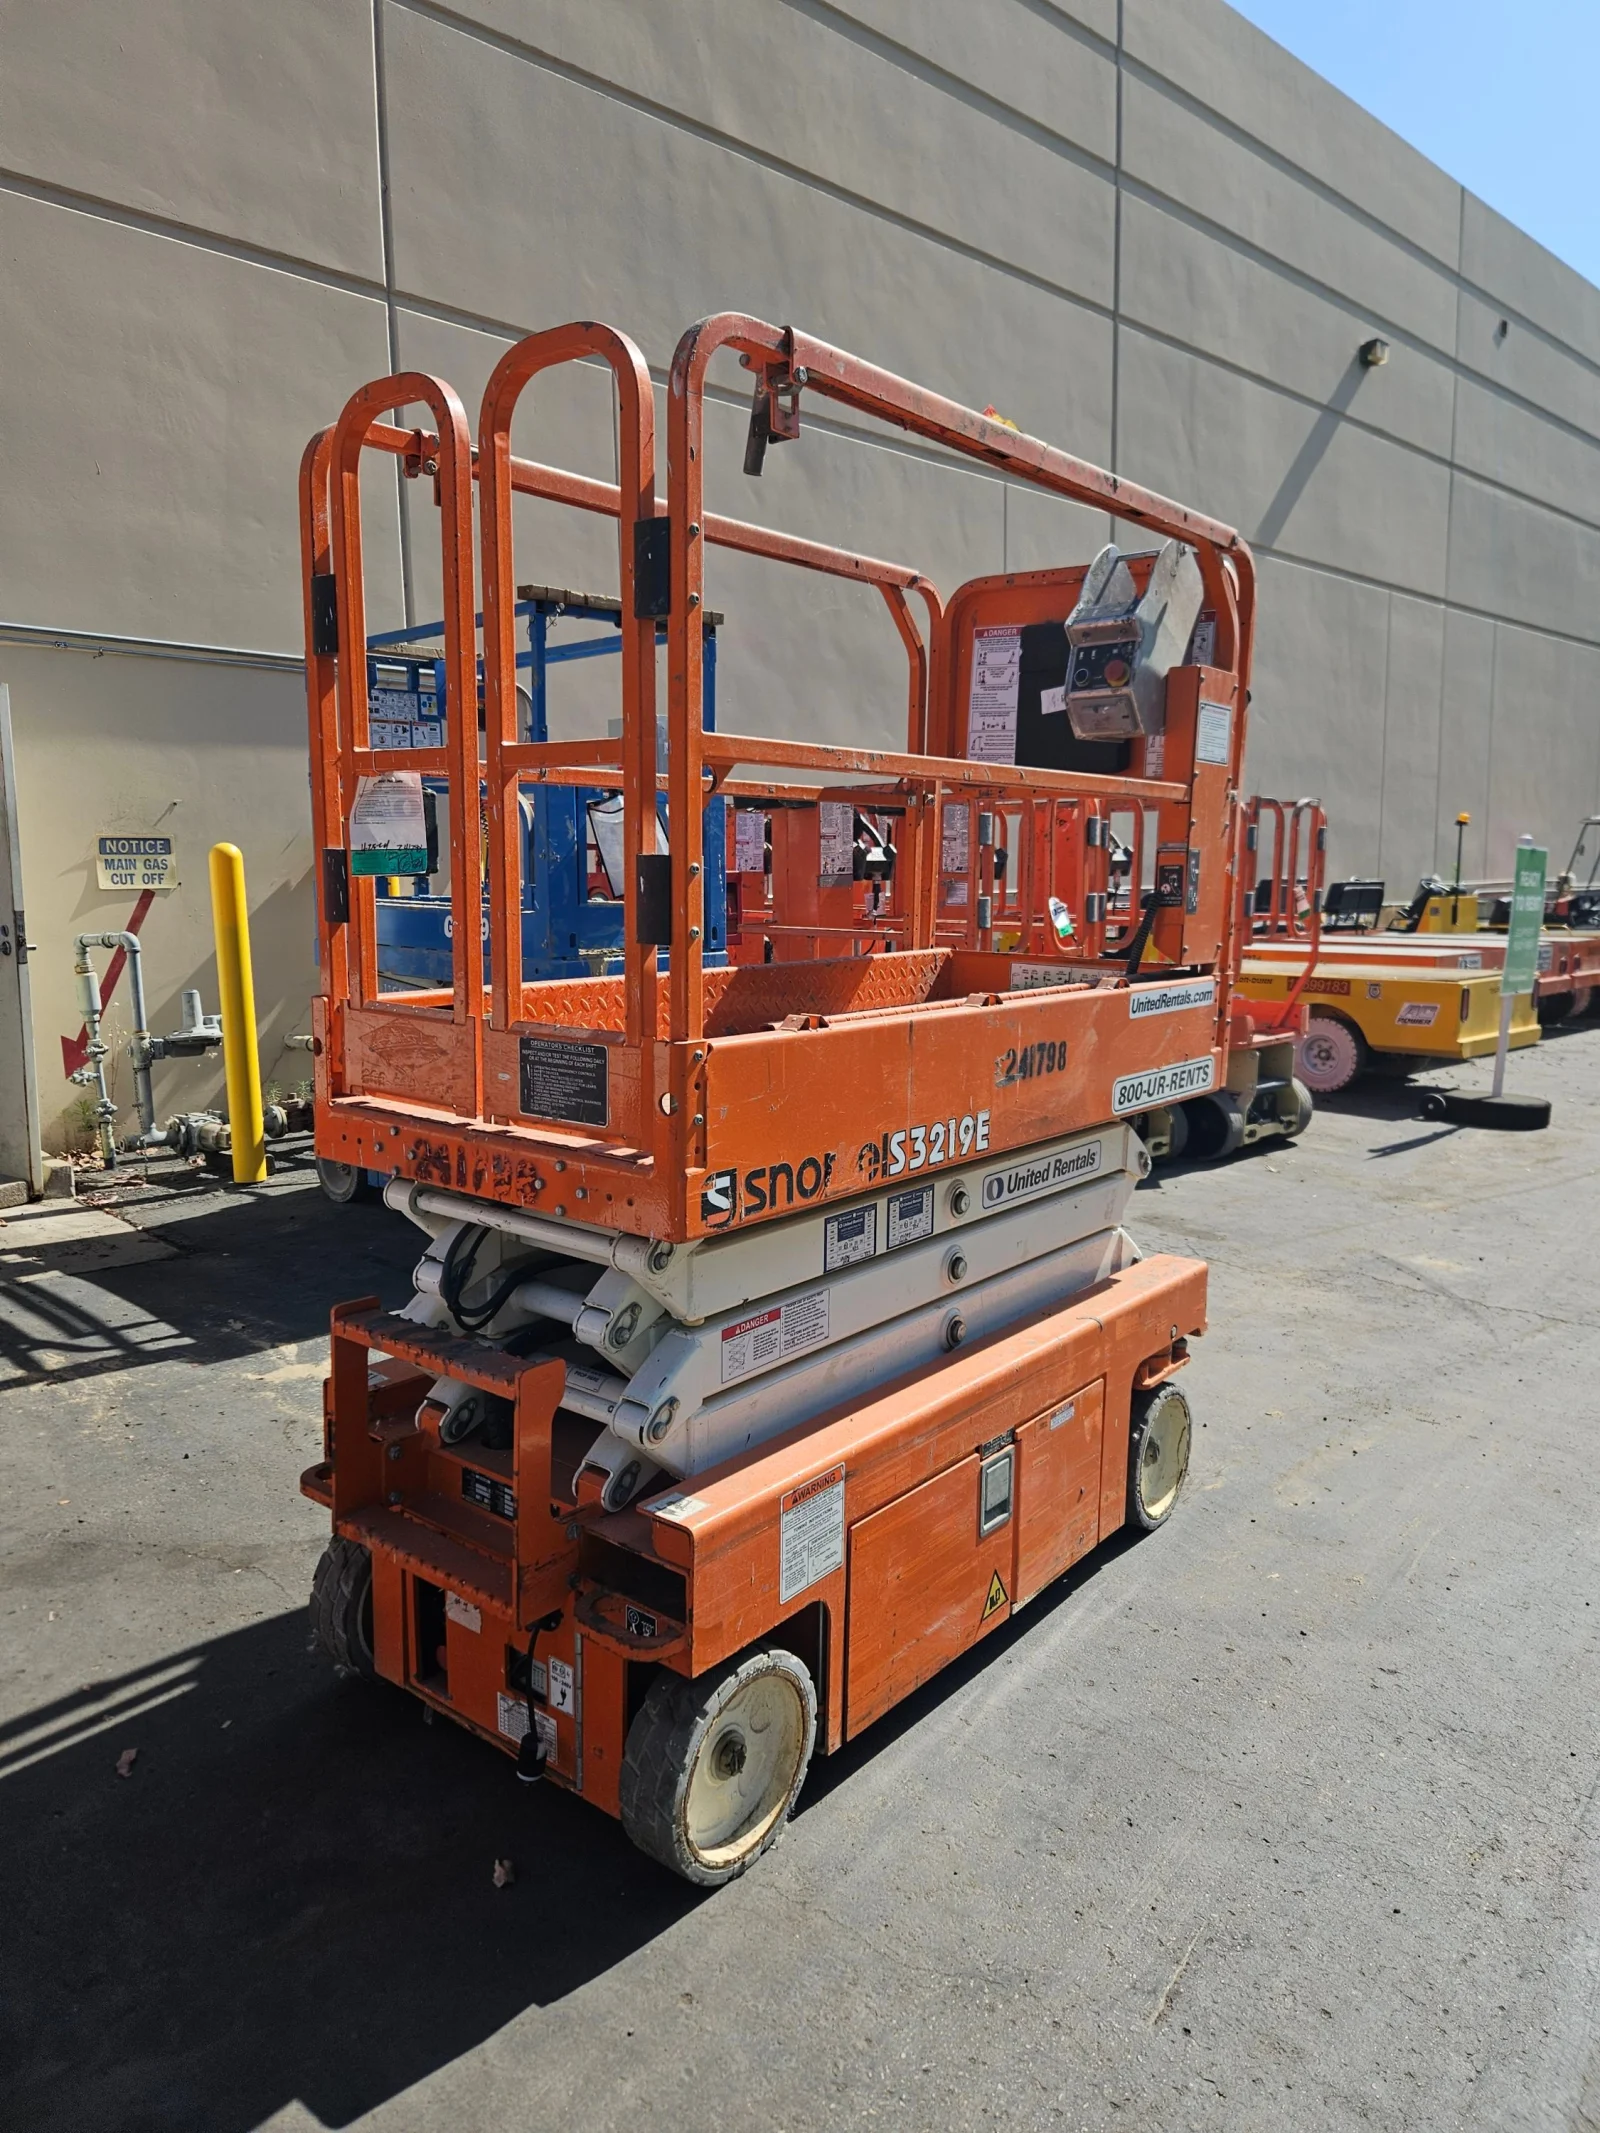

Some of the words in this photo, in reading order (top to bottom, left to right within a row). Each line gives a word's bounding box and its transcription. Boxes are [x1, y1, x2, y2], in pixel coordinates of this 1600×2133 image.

[988, 628, 1017, 637] DANGER
[105, 840, 165, 853] NOTICE
[104, 858, 137, 871] MAIN
[143, 858, 169, 871] GAS
[111, 873, 136, 885] CUT
[142, 873, 165, 885] OFF
[1131, 989, 1213, 1014] UnitedRentals.com
[563, 1045, 595, 1053] CHECKLIST
[1003, 1041, 1067, 1082] 241798
[1118, 1064, 1211, 1106] 800-UR-RENTS
[889, 1108, 992, 1176] S3219E
[1007, 1165, 1050, 1195] United
[1052, 1148, 1096, 1177] Rentals
[741, 1314, 769, 1332] DANGER
[798, 1472, 836, 1501] WARNING
